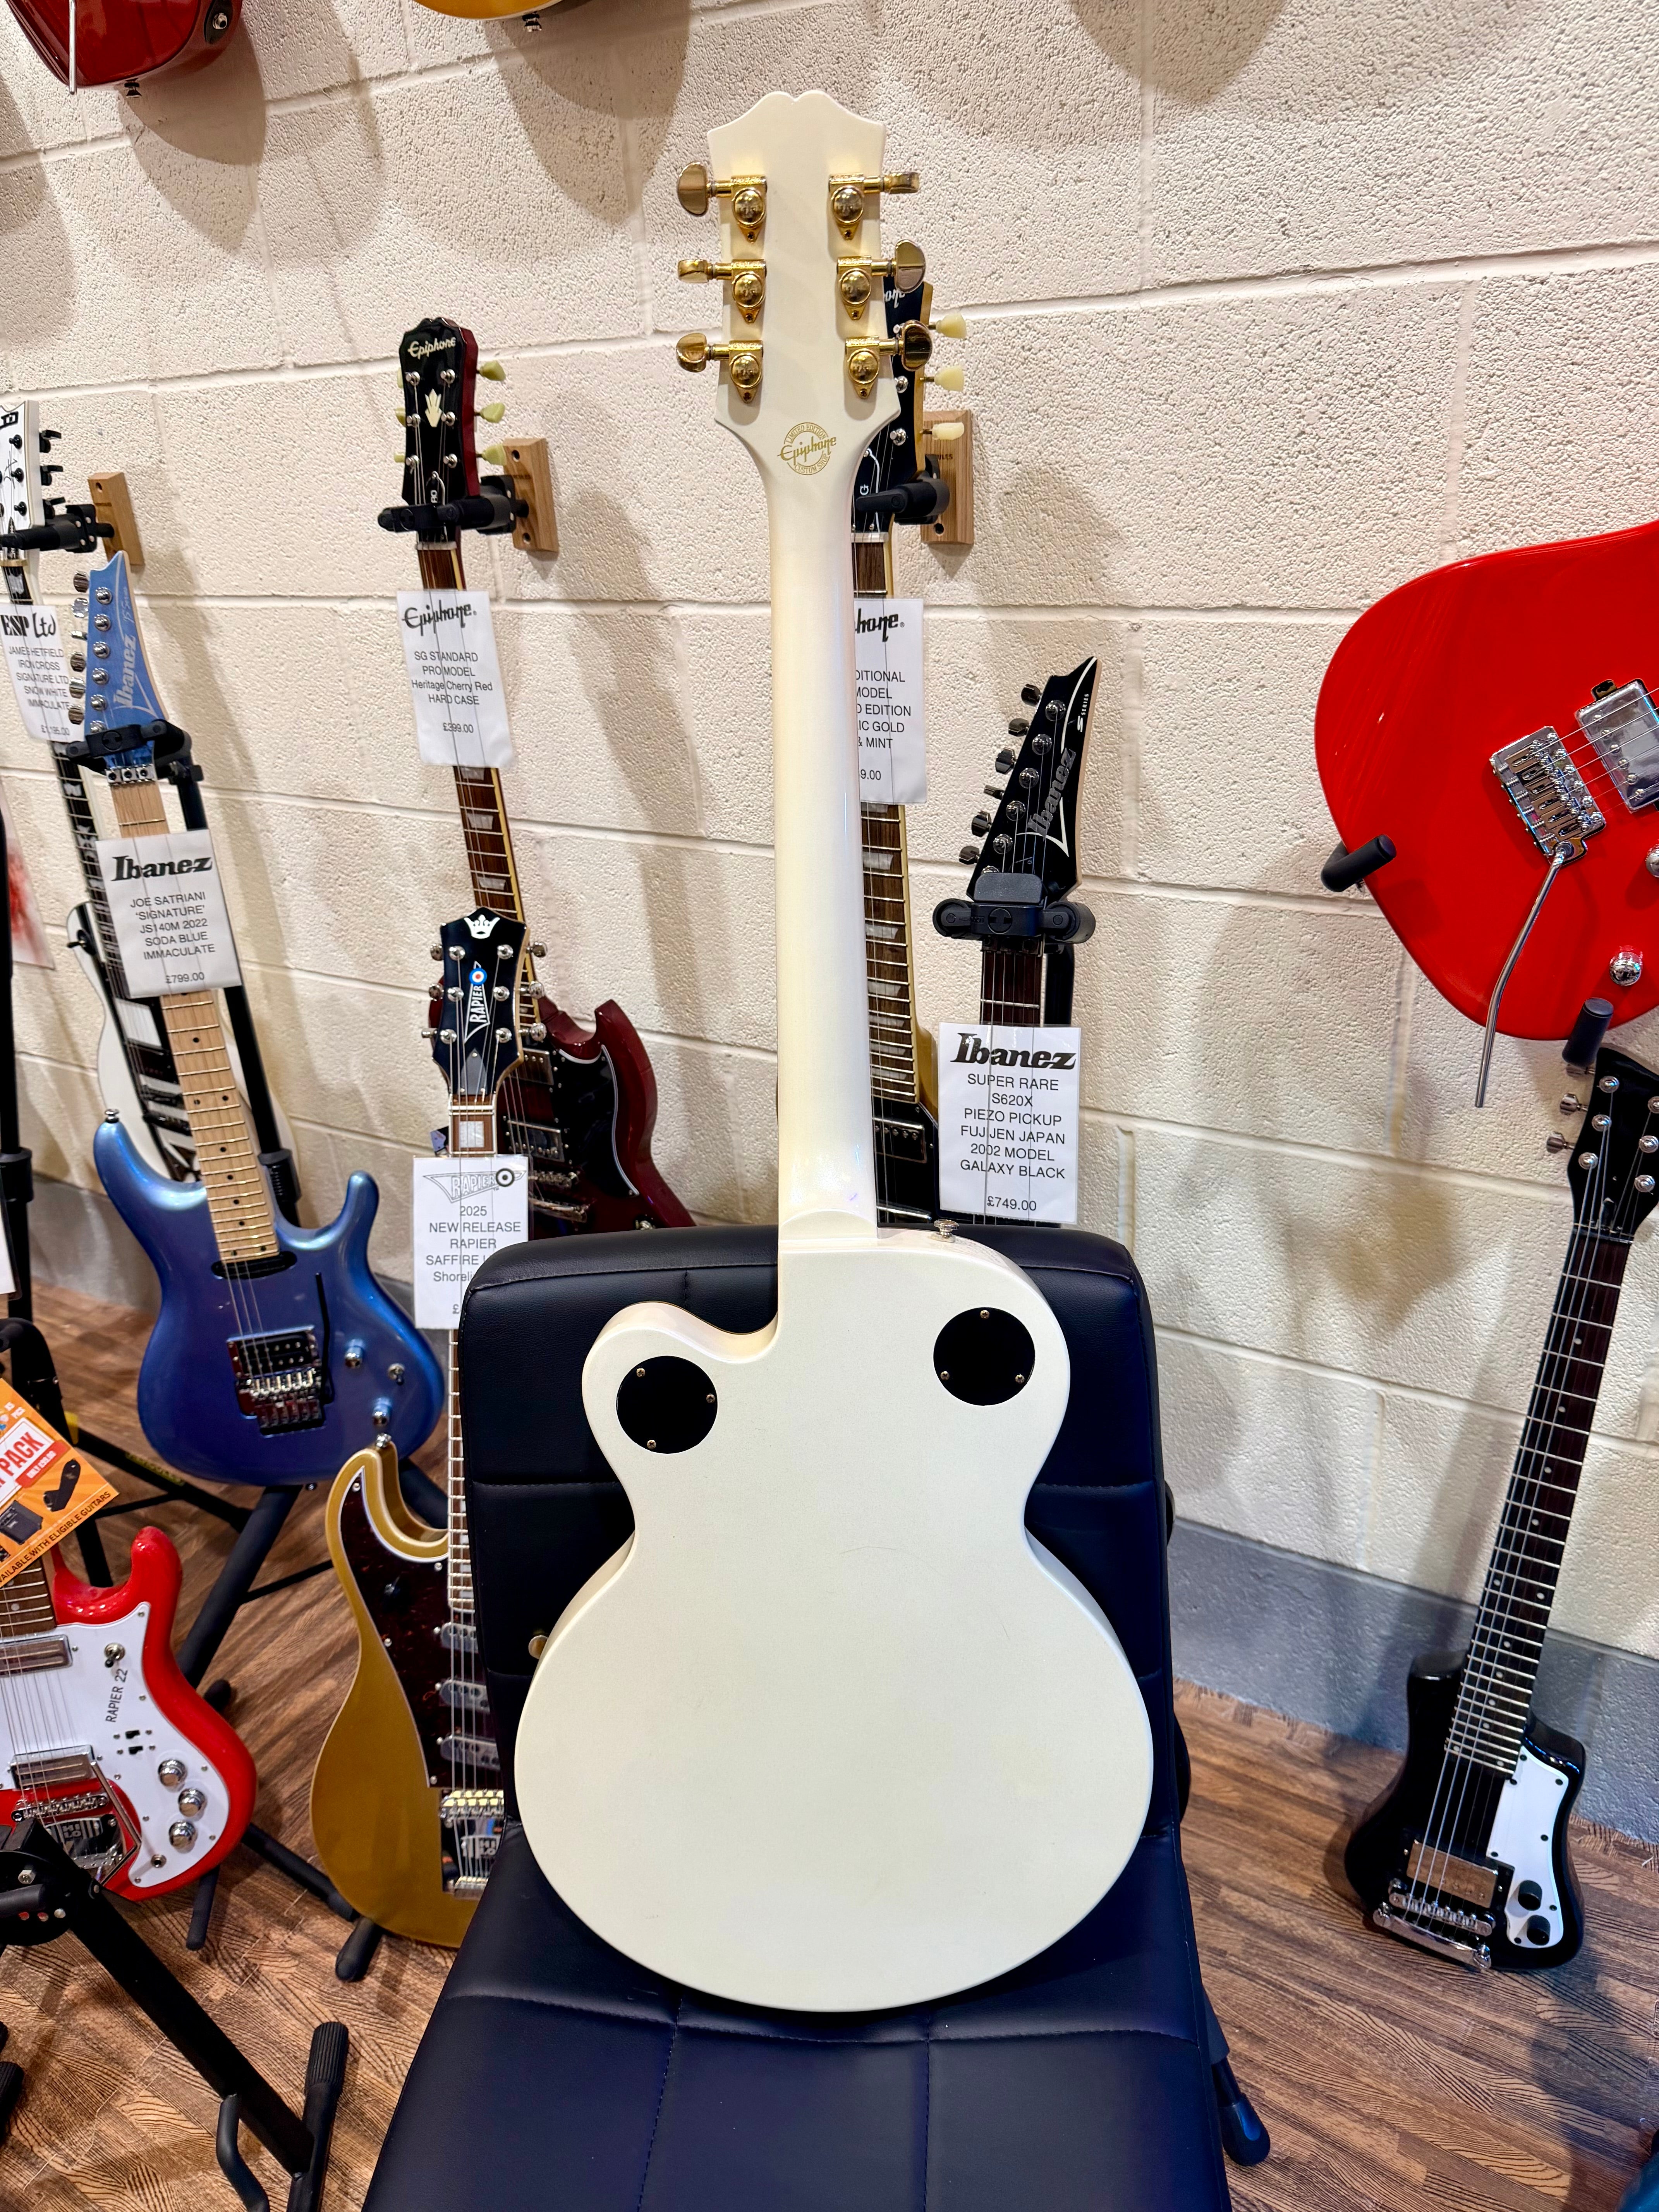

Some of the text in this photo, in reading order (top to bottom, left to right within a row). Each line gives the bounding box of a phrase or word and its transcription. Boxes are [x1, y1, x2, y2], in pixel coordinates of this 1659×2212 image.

[407, 337, 456, 359] Epiphone
[786, 424, 826, 443] LIMITED EDITION
[777, 436, 836, 465] Epiphone
[795, 453, 828, 474] CUSTOM SHOP
[0, 615, 29, 637] ESP
[9, 646, 64, 658] JAMES HETFIELD
[414, 651, 478, 662] SG STANDARD
[18, 660, 60, 671] IRON CROSS
[113, 634, 136, 708] Ibanez
[422, 666, 476, 677] PRO MODEL
[16, 673, 69, 684] SIGNATURE LTD
[856, 670, 905, 682] DITIONAL
[24, 686, 68, 697] SNOW WHITE
[412, 679, 493, 692] Heritage Cherry Red
[28, 699, 70, 709] IMMACULATE
[428, 694, 479, 705] HARD CASE
[1081, 694, 1089, 715] SERIES
[866, 704, 910, 716] EDITION
[872, 721, 904, 732] GOLD
[866, 737, 893, 748] MINT
[1027, 747, 1076, 842] Ibanez
[111, 855, 213, 881] Ibanez
[131, 891, 206, 908] JOE SATRIANI
[140, 918, 208, 934] JS140M 2022
[145, 931, 208, 946] SODA BLUE
[144, 944, 215, 960] IMMACULATE
[166, 972, 205, 984] £799.00
[470, 985, 487, 1023] RAPIER
[950, 1032, 1077, 1070] Ibanez
[968, 1073, 1059, 1091] SUPER RARE
[992, 1093, 1033, 1107] S620X
[964, 1108, 1061, 1126] PIEZO PICKUP
[961, 1125, 1065, 1144] FUJJEN JAPAN
[970, 1143, 1054, 1161] 2002 MODEL
[960, 1159, 1066, 1179] GALAXY BLACK
[451, 1174, 496, 1199] RAPIER
[460, 1206, 487, 1216] 2025
[987, 1195, 1037, 1211] £749.00
[429, 1222, 521, 1233] NEW RELEASE
[450, 1239, 496, 1249] RAPIER
[426, 1255, 479, 1265] SAFFIRE
[433, 1271, 472, 1282] Shoreli
[0, 1432, 45, 1476] PACK
[29, 1539, 50, 1556] WITH
[49, 1514, 82, 1541] ELIGIBLE
[80, 1491, 111, 1516] GUITARS
[105, 1669, 128, 1723] RAPIER 22
